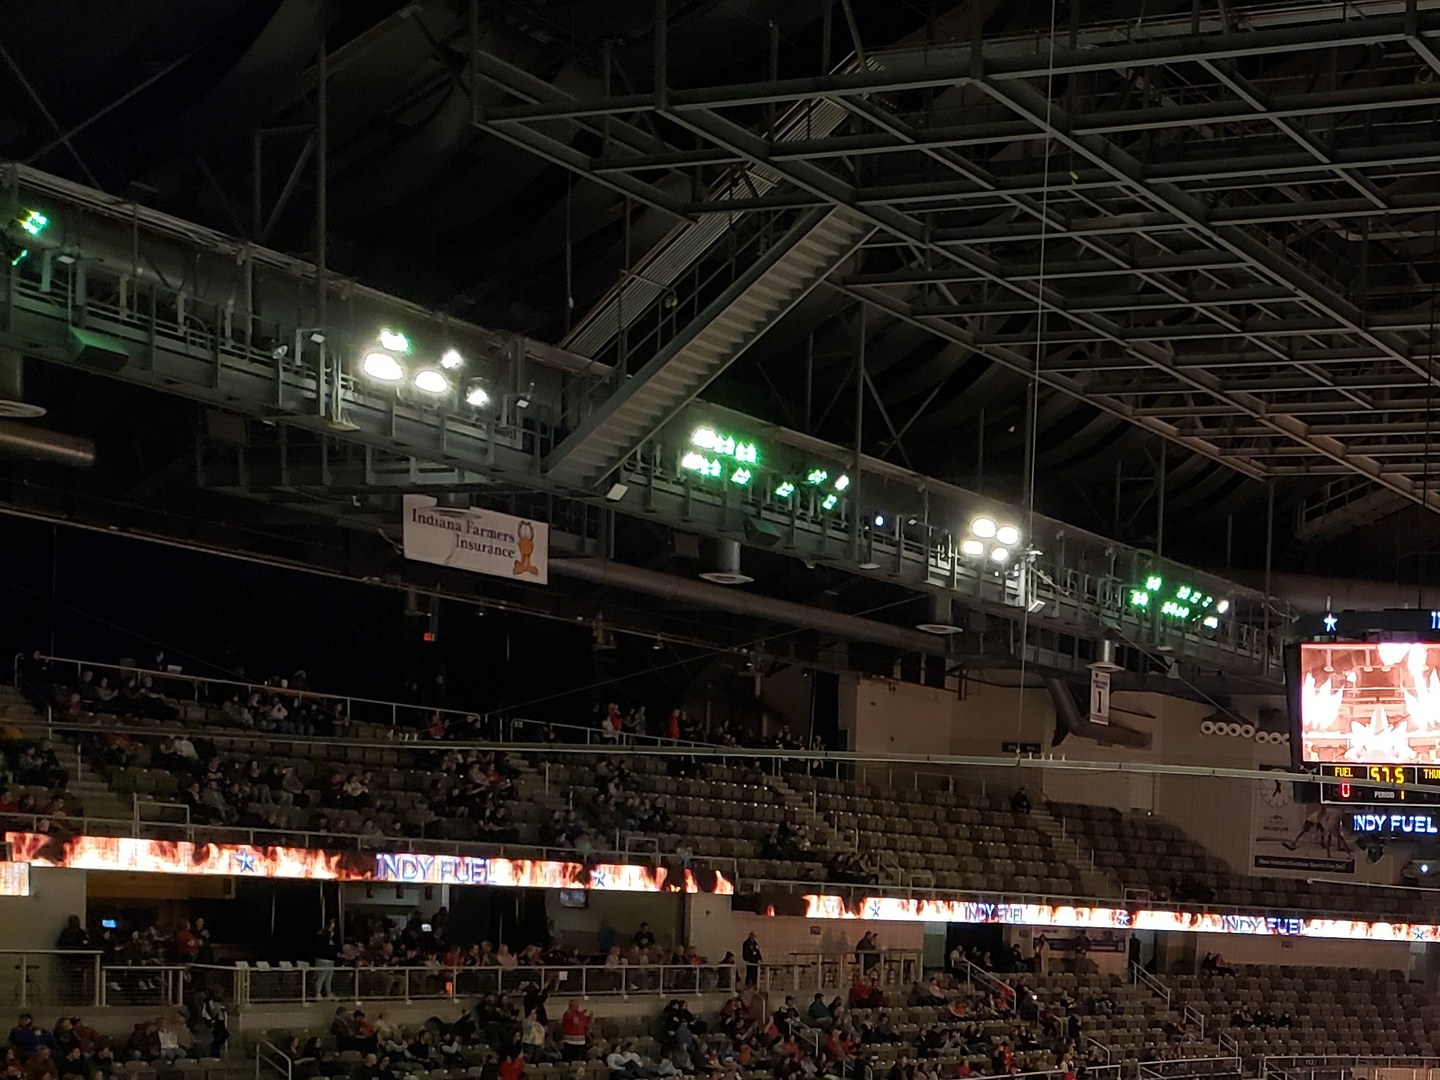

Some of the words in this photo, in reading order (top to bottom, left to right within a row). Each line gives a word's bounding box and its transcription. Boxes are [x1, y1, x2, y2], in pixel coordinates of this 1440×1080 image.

[412, 508, 462, 533] Indiana
[466, 519, 515, 544] Farmers
[456, 534, 515, 559] Insurance
[1334, 766, 1354, 778] FUEL
[1353, 814, 1387, 832] INDY
[1390, 815, 1438, 834] FUEL
[376, 853, 434, 881] INDY
[439, 857, 497, 885] FUEL
[964, 902, 996, 923] INDY
[998, 904, 1025, 923] FUEL
[1221, 914, 1261, 933] INDY
[1266, 917, 1305, 936] FUEL
